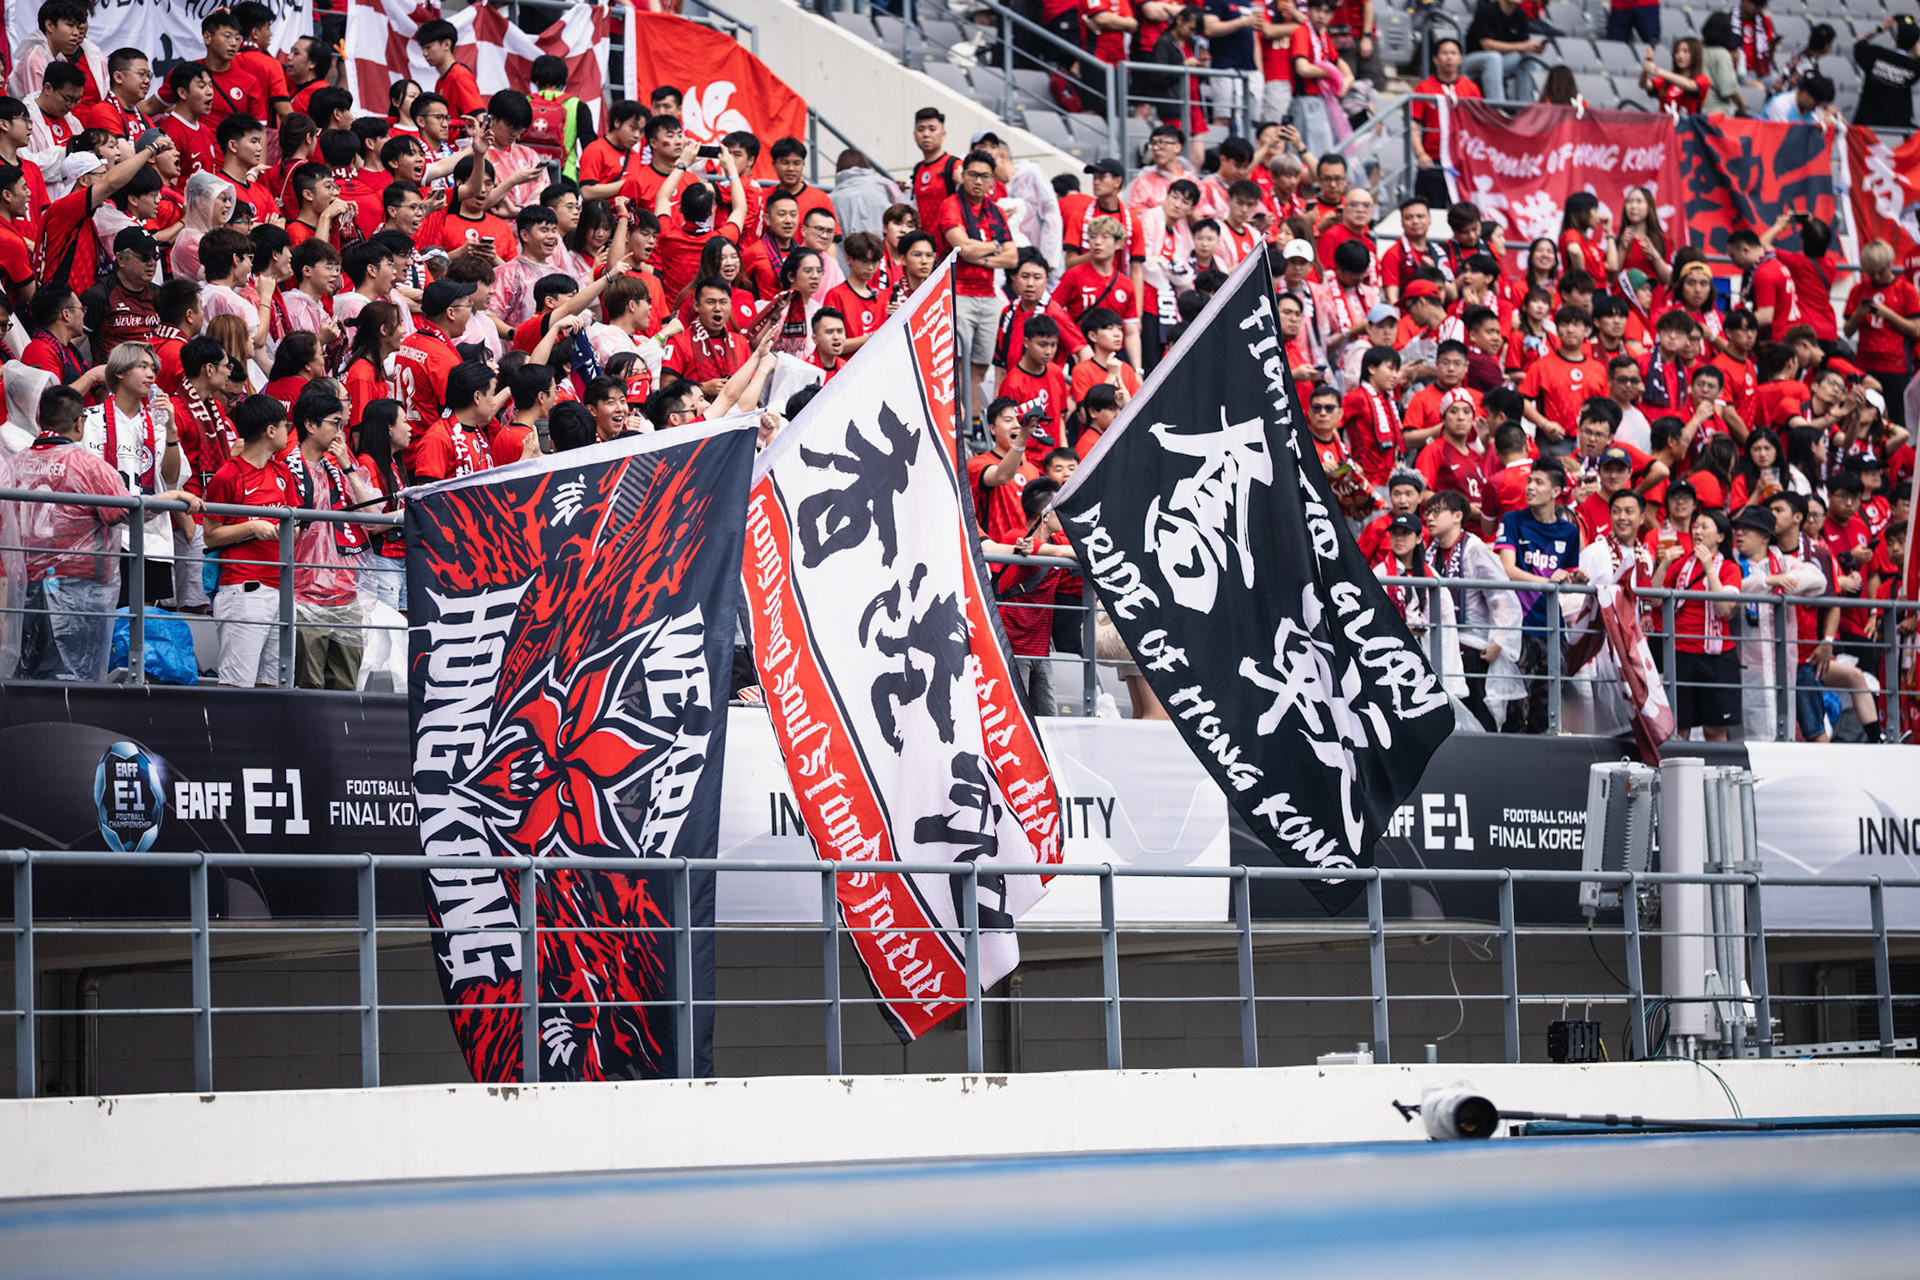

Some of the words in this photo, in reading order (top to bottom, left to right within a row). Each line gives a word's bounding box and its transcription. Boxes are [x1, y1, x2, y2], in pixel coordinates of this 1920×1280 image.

[1547, 143, 1573, 174] OF
[1573, 142, 1620, 172] HONG
[1622, 142, 1666, 173] KONG
[113, 315, 143, 327] NEVER
[395, 364, 421, 421] 12
[1524, 549, 1558, 570] edps
[642, 602, 712, 719] WE
[1330, 581, 1448, 720] GLORY
[409, 573, 537, 781] HONG
[1070, 501, 1160, 620] PRIDE
[1137, 629, 1189, 672] OF
[1168, 685, 1264, 791] HONG
[1252, 793, 1356, 884] KONG
[115, 762, 138, 778] EAFF
[113, 780, 145, 811] E-1
[174, 781, 233, 820] EAFF
[242, 768, 310, 835] E-1
[346, 779, 410, 796] FOOTBALL
[108, 820, 152, 828] CHAMPIONSHIP
[115, 813, 145, 821] FOOTBALL
[329, 801, 386, 826] FINAL
[1382, 805, 1415, 837] AFF
[1421, 793, 1474, 851] E-1
[1503, 808, 1557, 824] FOOTBALL
[1489, 825, 1537, 849] FINAL
[420, 792, 523, 990] KONG
